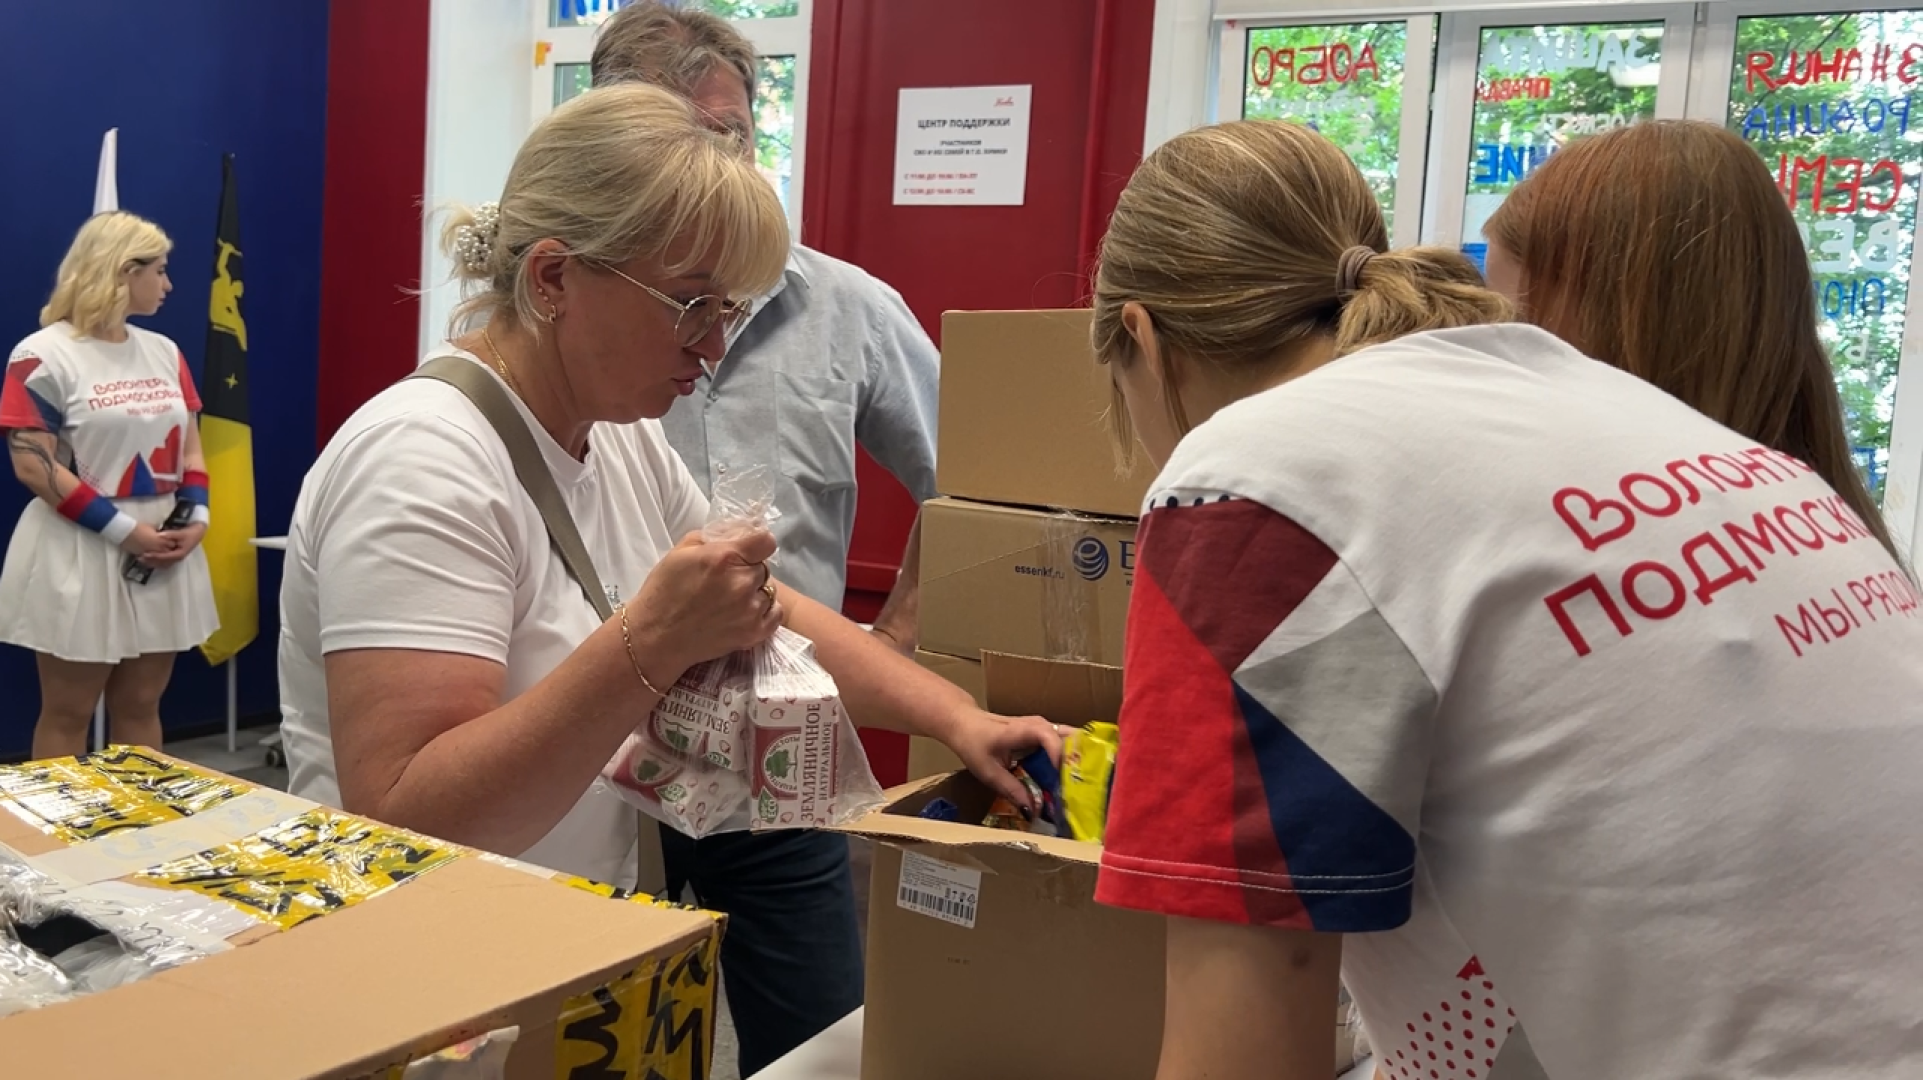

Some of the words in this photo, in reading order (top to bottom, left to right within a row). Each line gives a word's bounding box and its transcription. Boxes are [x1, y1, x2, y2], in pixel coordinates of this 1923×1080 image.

[918, 120, 947, 130] ЦЕНТР
[950, 119, 1010, 129] ПОДДЕРЖКИ
[1014, 564, 1066, 580] essenkf.ru
[1775, 588, 1861, 658] МЫ
[801, 703, 821, 822] ЗЕМЛЯНИЧНОЕ
[818, 721, 832, 801] НАТУРАЛЬНОЕ
